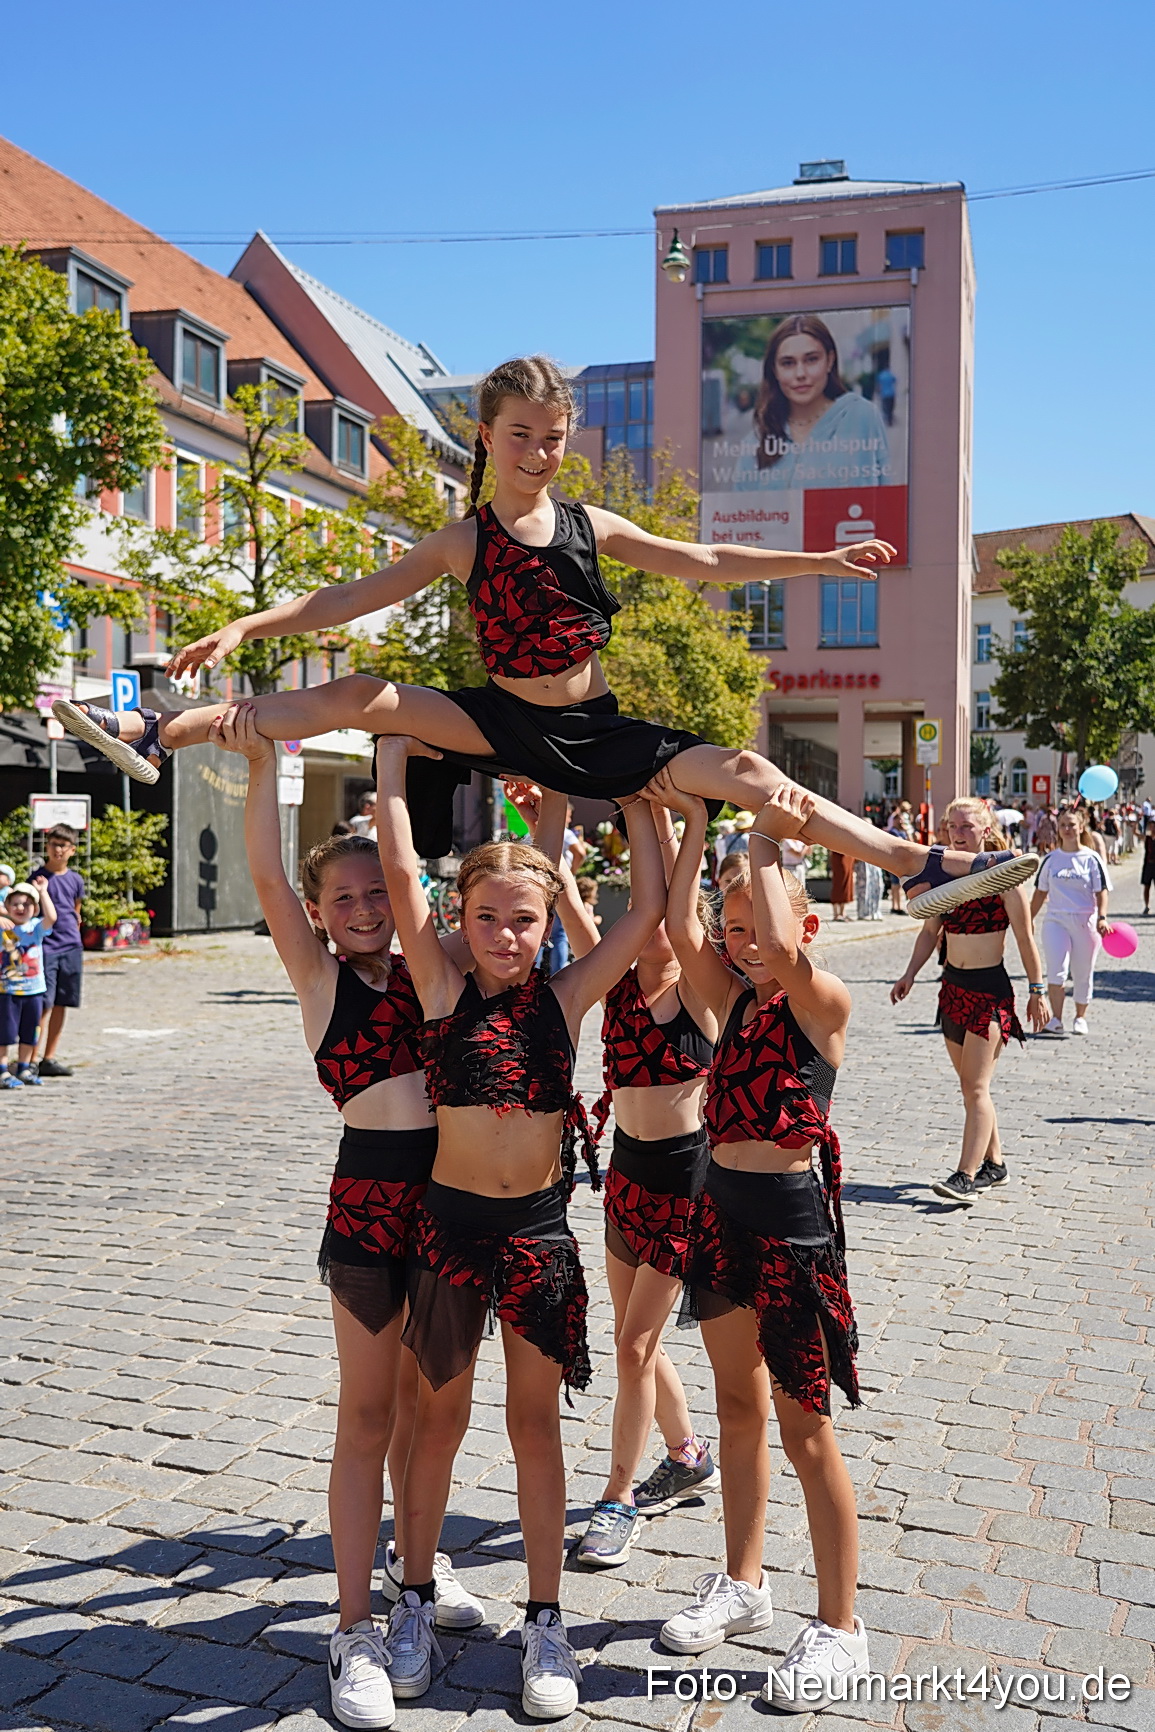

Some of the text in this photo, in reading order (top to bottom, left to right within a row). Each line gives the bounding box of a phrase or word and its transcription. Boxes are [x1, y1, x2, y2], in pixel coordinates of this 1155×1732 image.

[712, 434, 885, 458] Mehr Überholspur.
[712, 466, 790, 485] Weniger
[712, 509, 790, 524] Ausbildung
[712, 530, 765, 542] bei uns.
[769, 668, 881, 694] Sparkasse
[116, 677, 134, 711] P
